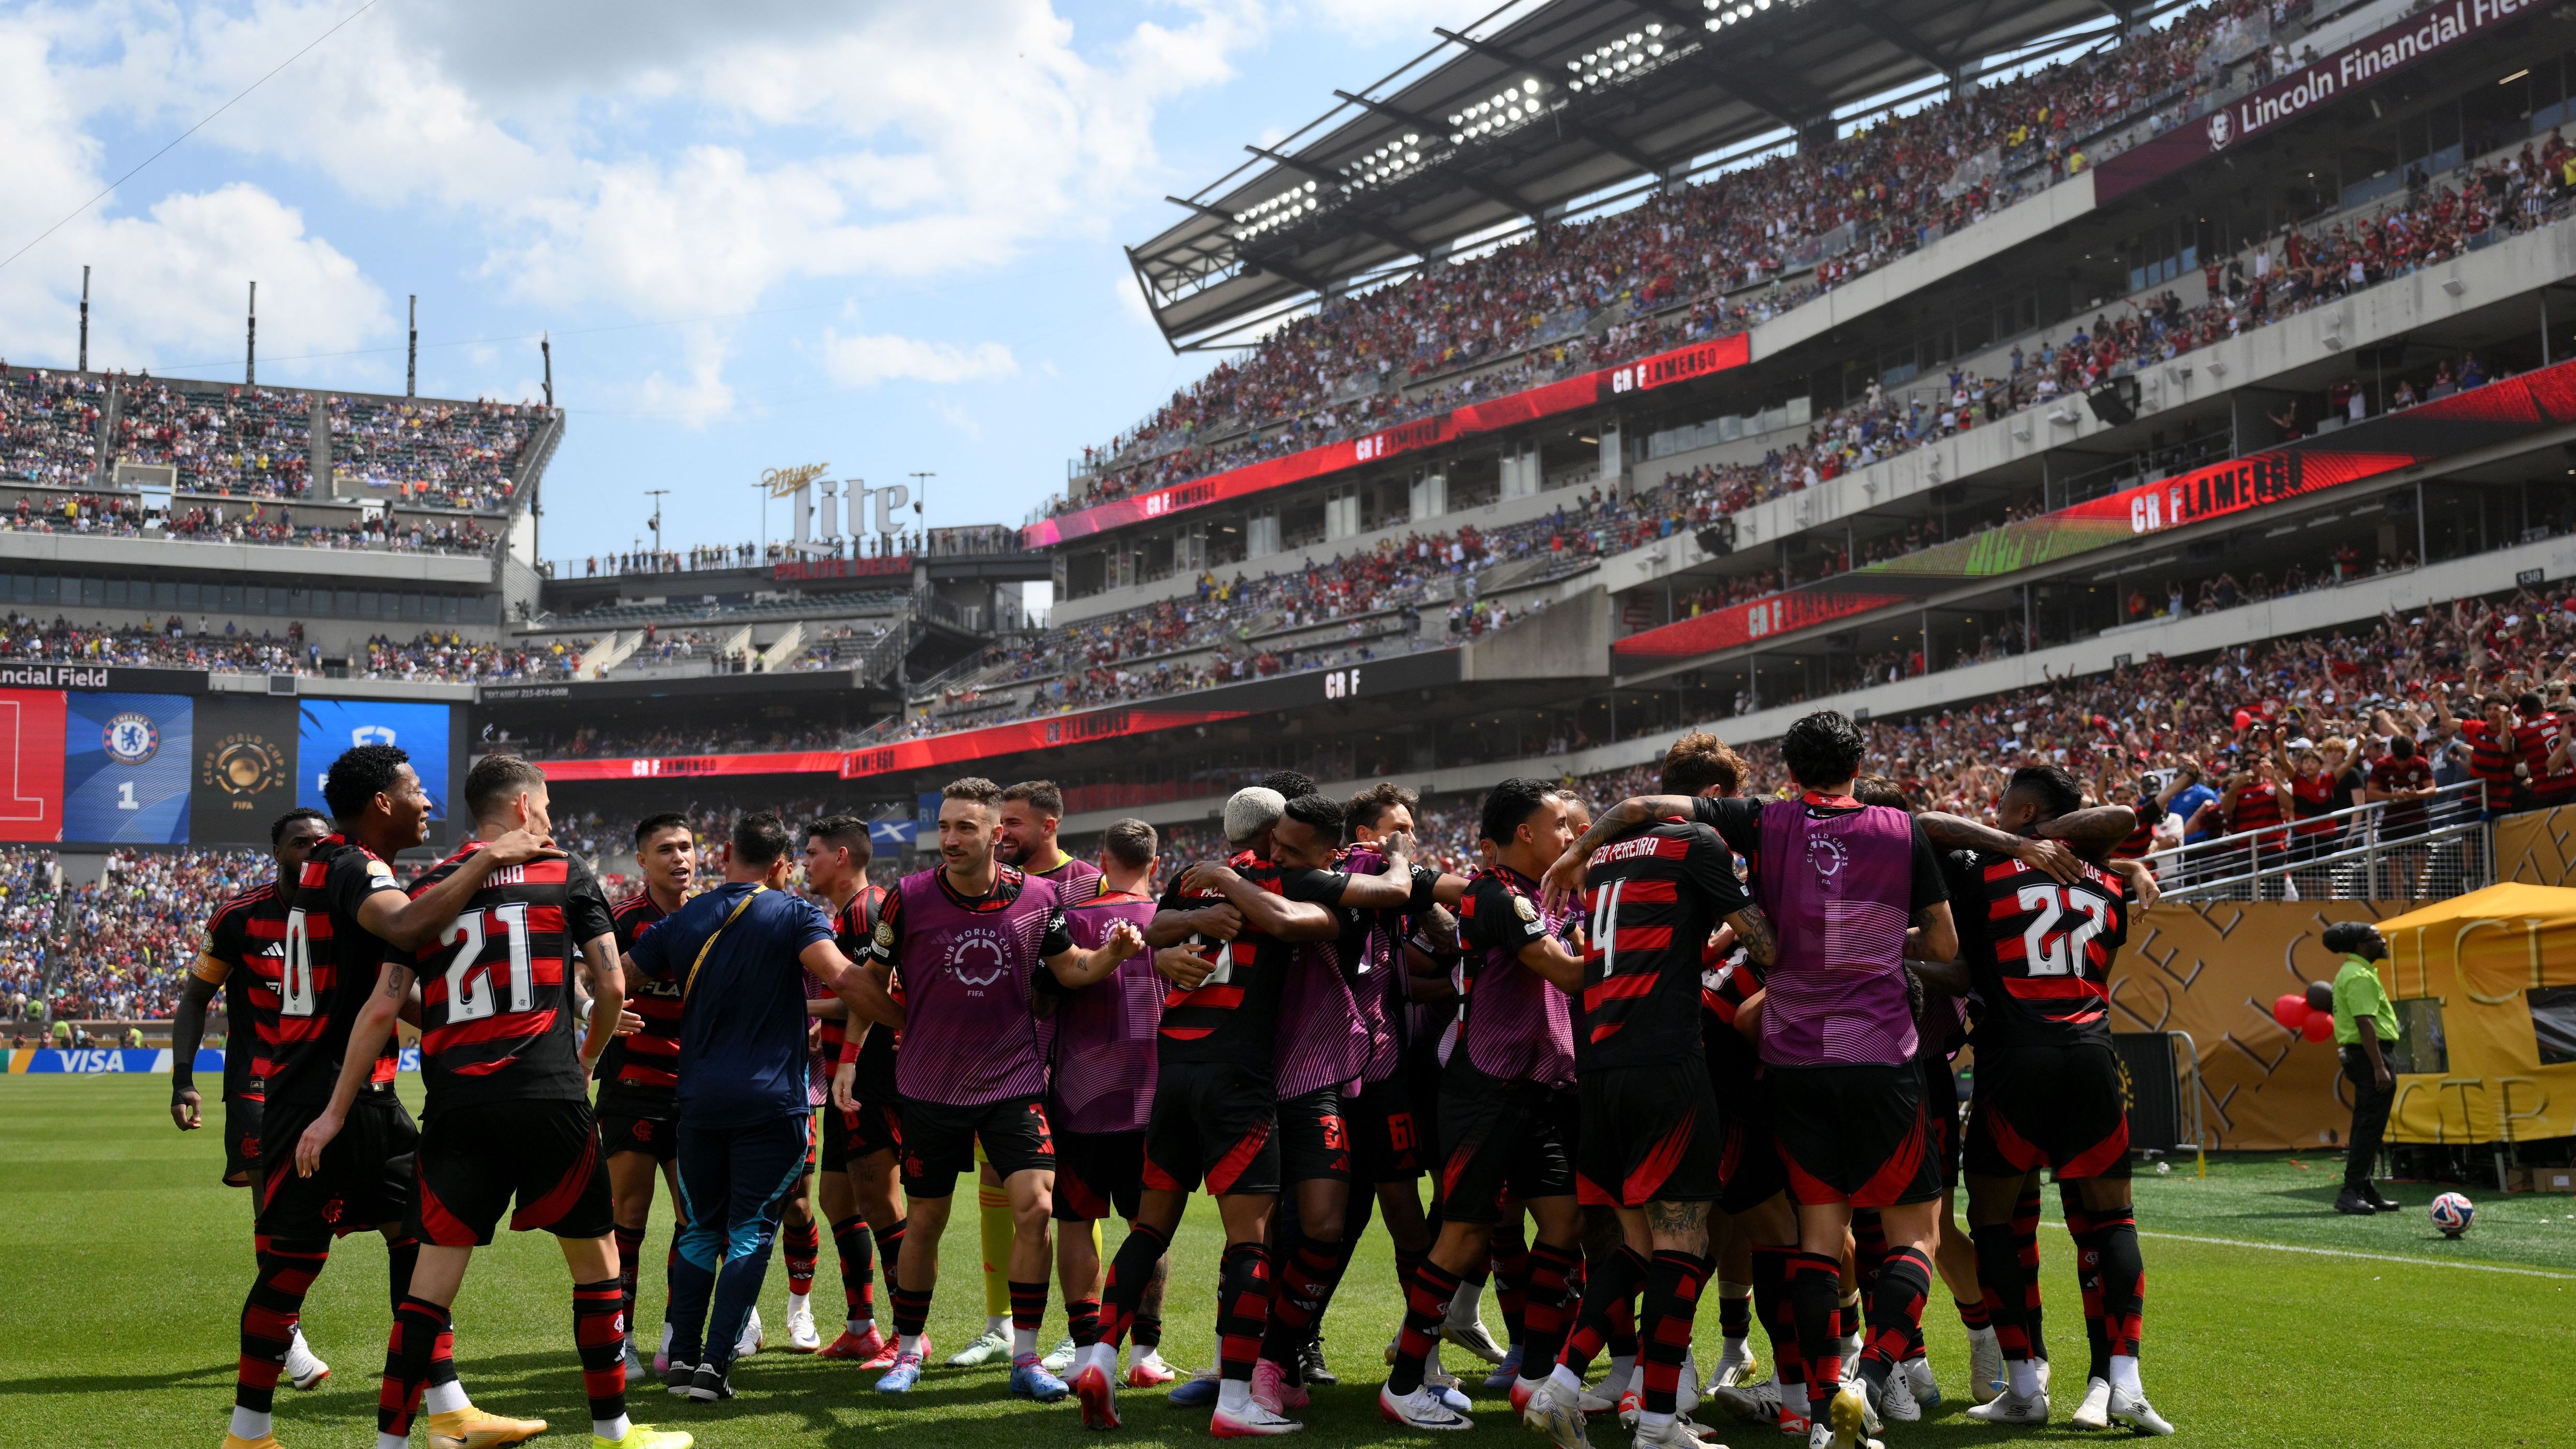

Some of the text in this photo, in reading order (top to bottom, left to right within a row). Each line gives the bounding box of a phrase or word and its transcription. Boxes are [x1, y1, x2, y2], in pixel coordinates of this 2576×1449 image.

[2242, 0, 2538, 133] Lincoln Financial Fie
[1613, 368, 1633, 393] CR
[1356, 438, 1372, 461] CR
[762, 462, 830, 498] Miller
[788, 479, 909, 557] Lite
[1146, 495, 1161, 515] CR
[2131, 492, 2160, 533] CR
[774, 555, 912, 581] PHLITE DECK
[0, 667, 108, 687] ncial Field
[1325, 671, 1345, 699] CR
[632, 760, 649, 776] CR
[118, 781, 139, 810] 1
[1609, 837, 1659, 861] PEREIRA
[1833, 838, 1846, 852] CUP
[1104, 917, 1128, 928] WORLD
[1592, 877, 1626, 977] 4
[439, 902, 534, 1024] 21
[944, 928, 1012, 976] CLUB WORLD CUP 25
[55, 1050, 124, 1072] VISA
